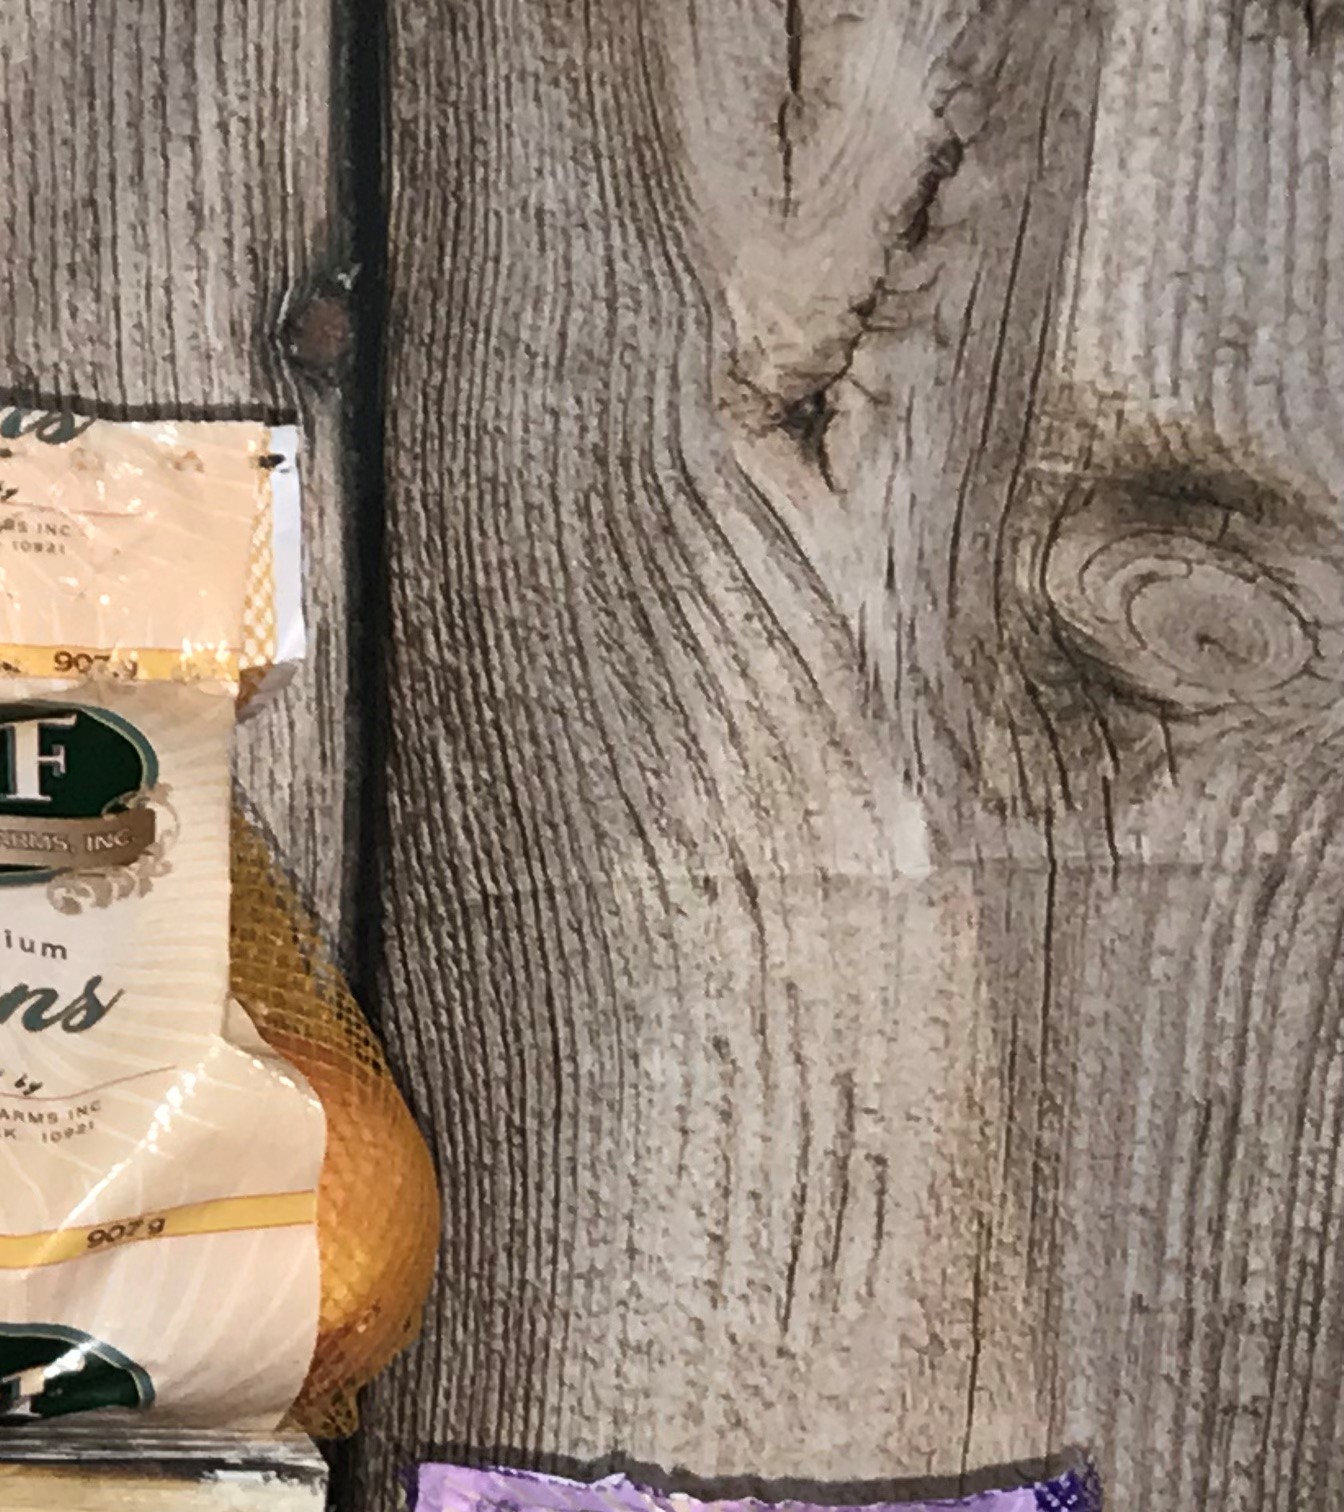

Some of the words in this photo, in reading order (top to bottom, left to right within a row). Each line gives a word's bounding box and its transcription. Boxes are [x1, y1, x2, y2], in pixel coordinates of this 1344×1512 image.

[14, 1062, 45, 1097] by
[68, 1100, 103, 1121] INC
[85, 1221, 142, 1250] 907
[145, 1216, 167, 1237] g
